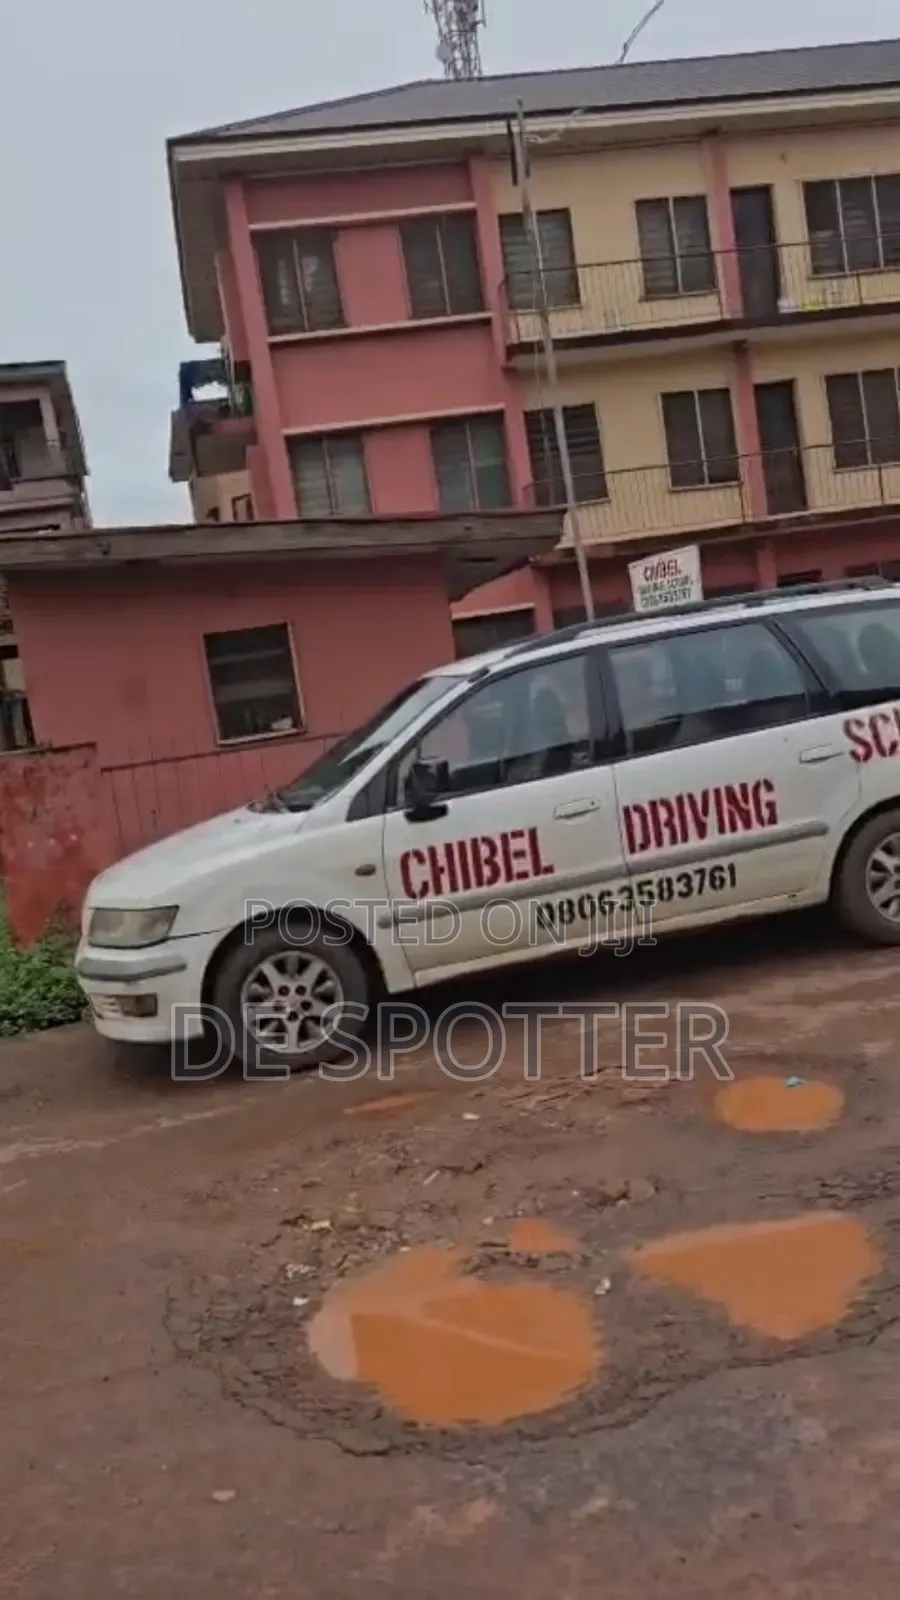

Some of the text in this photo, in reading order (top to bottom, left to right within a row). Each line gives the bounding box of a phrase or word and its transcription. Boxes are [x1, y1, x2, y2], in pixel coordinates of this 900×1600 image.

[400, 828, 554, 901] CHIBEL
[622, 778, 778, 854] DRIVING
[535, 863, 738, 929] 08063583761
